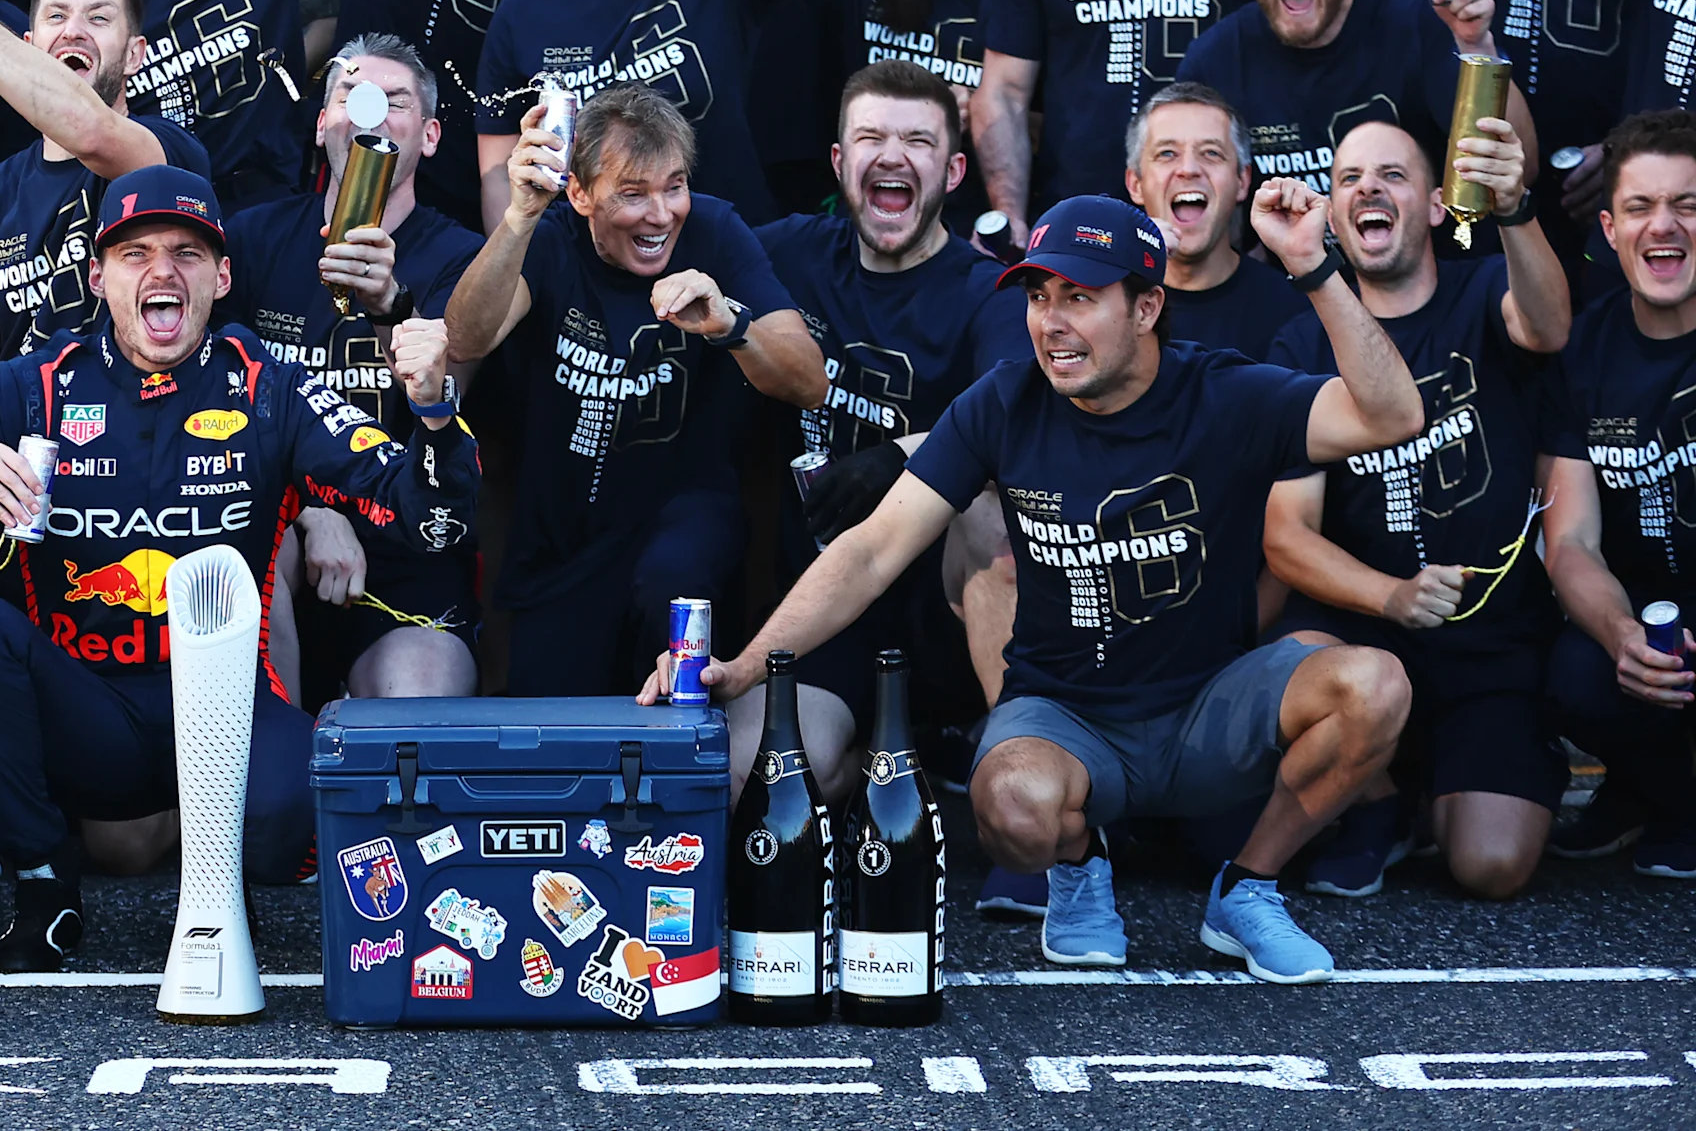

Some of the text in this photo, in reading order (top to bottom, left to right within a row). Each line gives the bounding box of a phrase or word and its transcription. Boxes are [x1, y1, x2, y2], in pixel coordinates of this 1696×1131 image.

[126, 28, 251, 98] CHAMPIONS
[543, 46, 594, 56] ORACLE
[1255, 146, 1333, 175] WORLD
[121, 193, 138, 218] 1
[1076, 225, 1113, 237] ORACLE
[256, 309, 306, 326] ORACLE
[556, 335, 626, 376] WORLD
[63, 407, 103, 420] TAG
[60, 421, 104, 445] HEUER
[186, 450, 246, 476] BYBIT
[1587, 440, 1662, 469] WORLD
[54, 458, 95, 476] obil
[180, 480, 252, 496] HONDA
[1007, 487, 1064, 503] ORACLE
[46, 500, 253, 539] ORACLE
[1016, 511, 1096, 544] WORLD
[1028, 529, 1189, 568] CHAMPIONS
[1065, 568, 1093, 578] 2010
[1070, 578, 1096, 586] 2011
[1070, 586, 1097, 597] 2012
[1071, 597, 1099, 607] 2013
[1070, 607, 1100, 617] 2022
[1071, 617, 1101, 628] 2023
[50, 611, 146, 665] Red
[485, 828, 558, 852] YETI
[343, 841, 390, 869] AUSTRALIA
[628, 837, 701, 871] Austria
[815, 804, 838, 996] FERRARI
[927, 801, 947, 994] FERRARI
[452, 903, 481, 923] JEDDAH
[562, 904, 606, 946] BARCELONA
[181, 942, 216, 950] Formula
[650, 933, 690, 942] MONACO
[353, 931, 404, 971] Miami
[731, 958, 801, 973] FERRARI
[842, 957, 914, 974] FERRARI
[418, 985, 467, 998] BELGIUM
[525, 970, 564, 996] BUDAPEST
[585, 966, 648, 1003] ZAND
[580, 980, 642, 1018] VOORT
[577, 1049, 1696, 1094] CIRC
